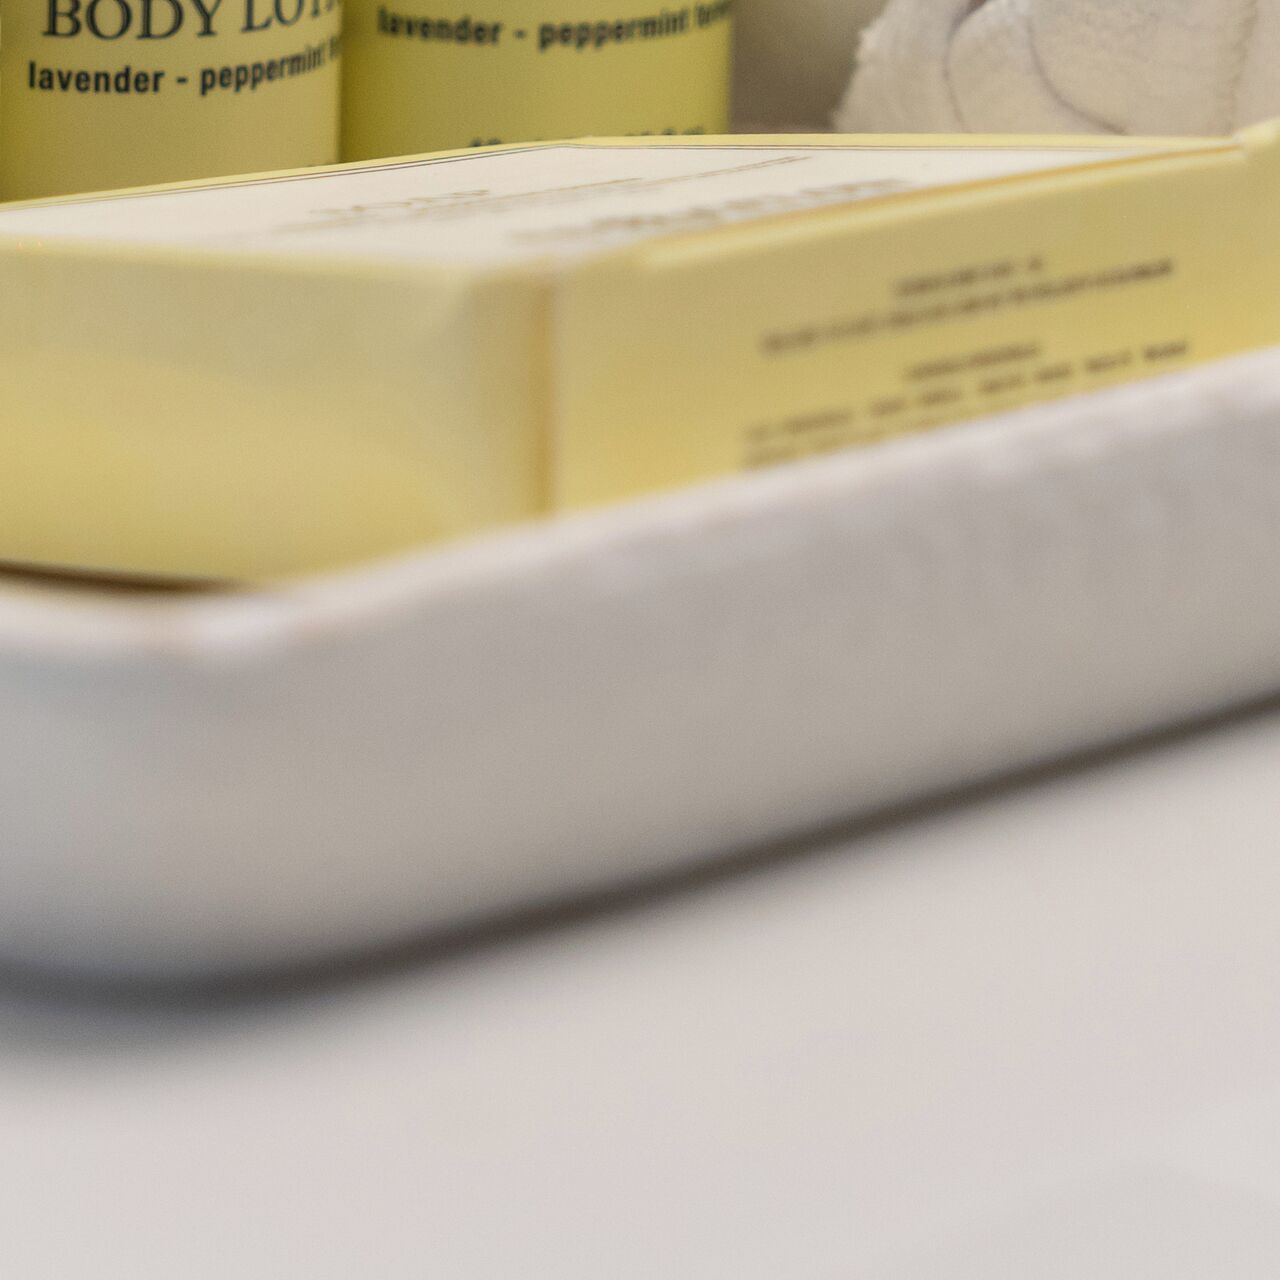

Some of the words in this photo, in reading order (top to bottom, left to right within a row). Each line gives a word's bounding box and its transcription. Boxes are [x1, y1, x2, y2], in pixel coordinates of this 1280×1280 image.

[377, 4, 504, 47] lavender
[538, 6, 689, 52] peppermint
[28, 60, 165, 94] lavender
[200, 43, 325, 96] peppermint
